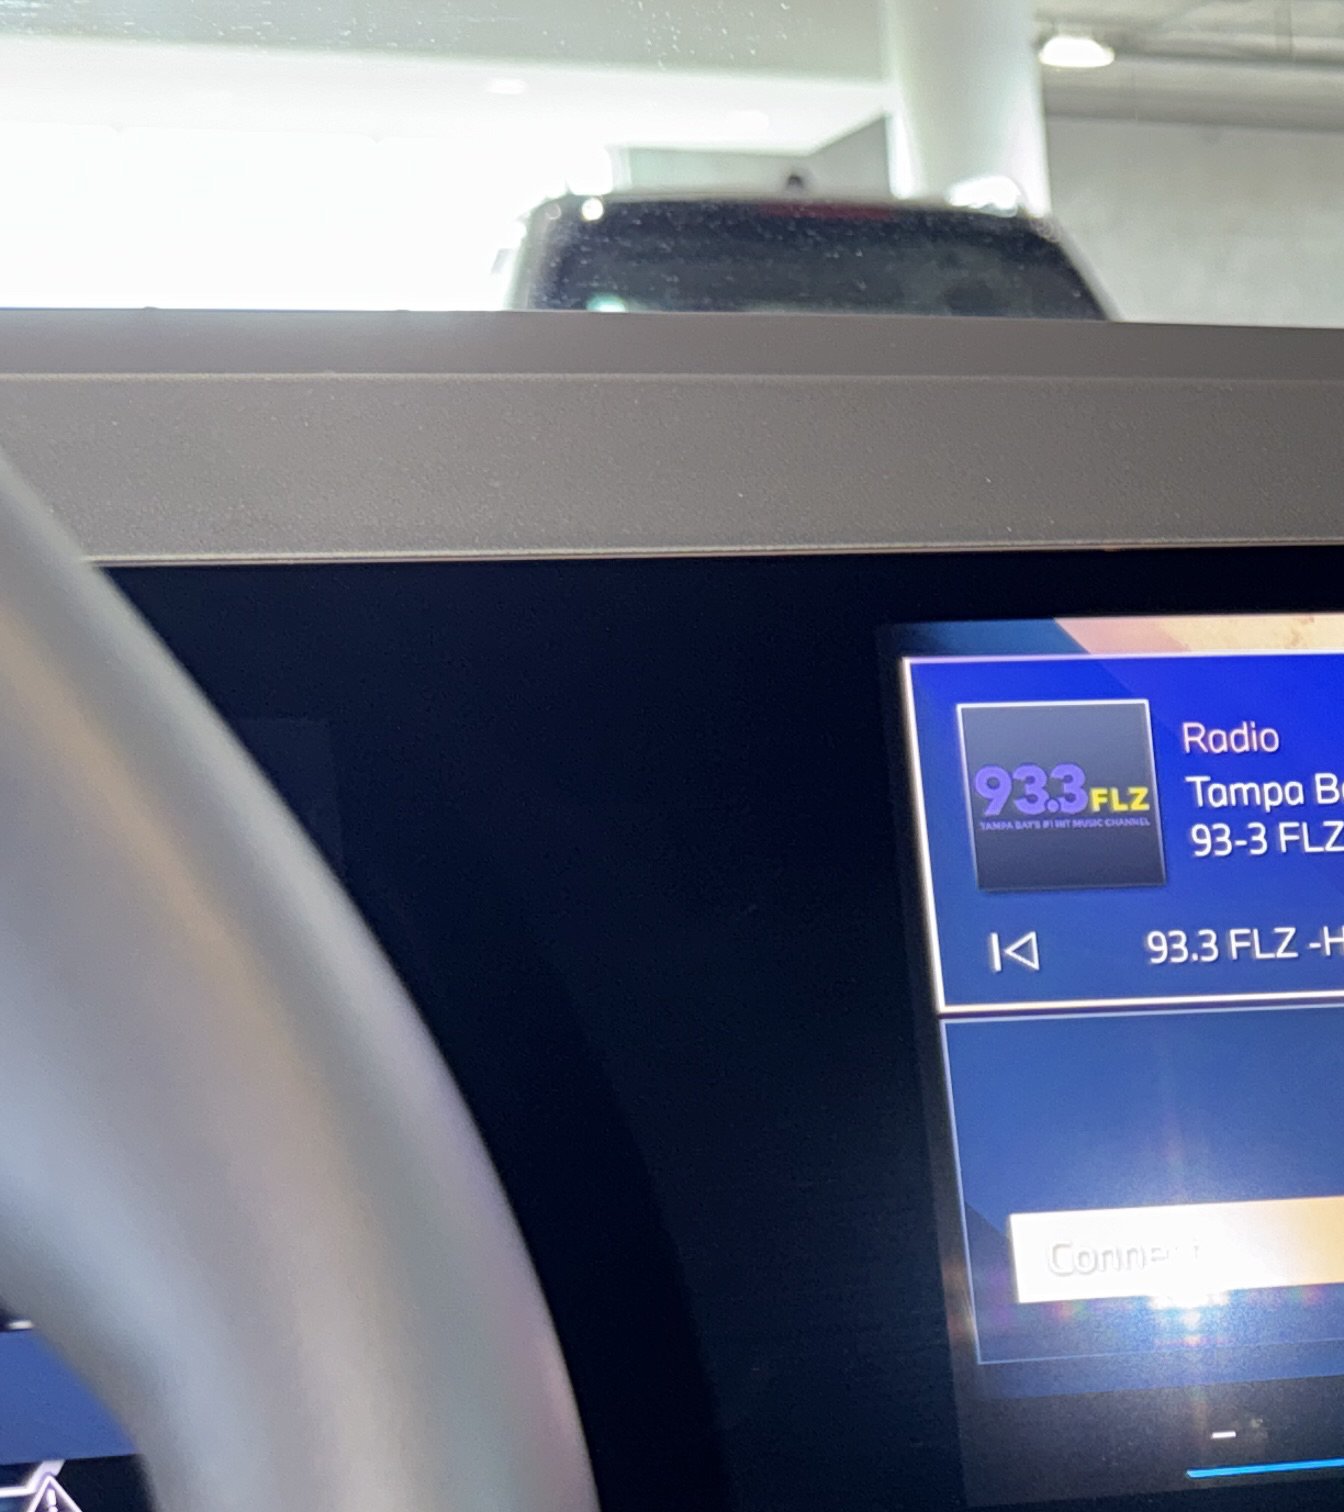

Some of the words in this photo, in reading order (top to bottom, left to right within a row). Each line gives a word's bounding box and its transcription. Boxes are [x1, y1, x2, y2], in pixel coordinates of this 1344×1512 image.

[1182, 720, 1280, 754] Radio
[974, 763, 1089, 817] 93.3
[1089, 786, 1150, 813] FLZ
[1185, 775, 1305, 813] Tampa
[980, 820, 1014, 831] TAMPA
[1104, 817, 1150, 828] CHANNEL
[1190, 822, 1268, 857] 93-3
[1146, 929, 1219, 964] 93.3
[1229, 926, 1299, 960] FLZ
